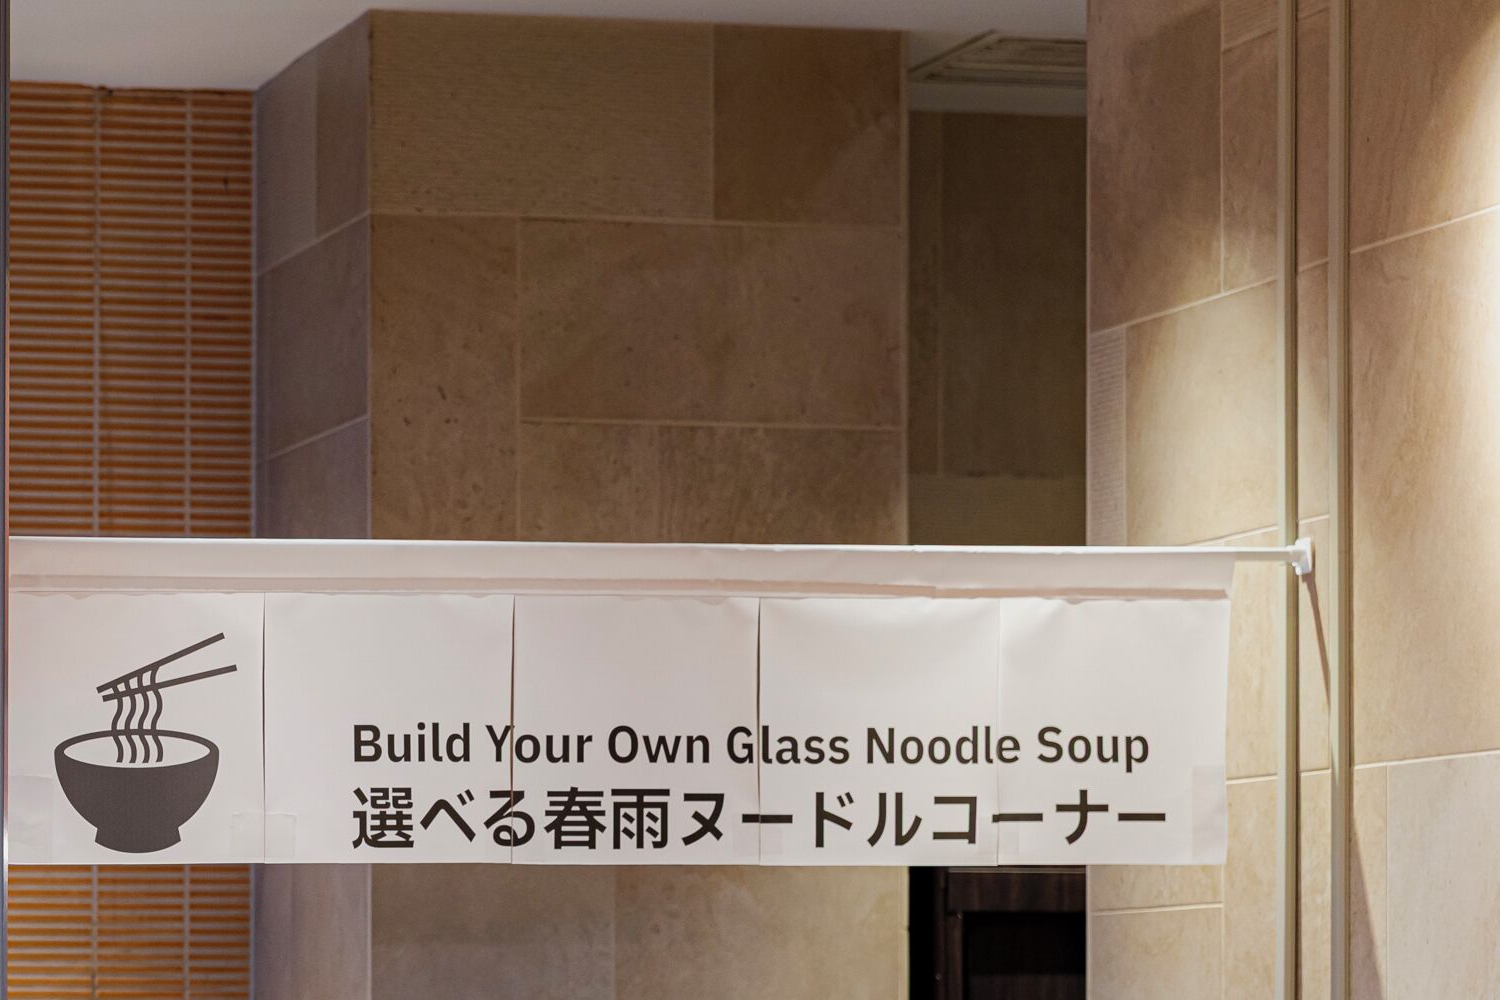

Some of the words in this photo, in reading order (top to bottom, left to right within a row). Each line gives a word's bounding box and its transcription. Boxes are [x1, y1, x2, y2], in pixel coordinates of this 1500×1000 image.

[354, 722, 470, 762] Build
[486, 725, 592, 763] Your
[608, 725, 710, 764] Own
[727, 725, 849, 764] Glass
[867, 726, 1020, 764] Noodle
[1038, 726, 1148, 773] Soup
[352, 787, 1166, 850] 選べる春雨ヌードルコーナー
